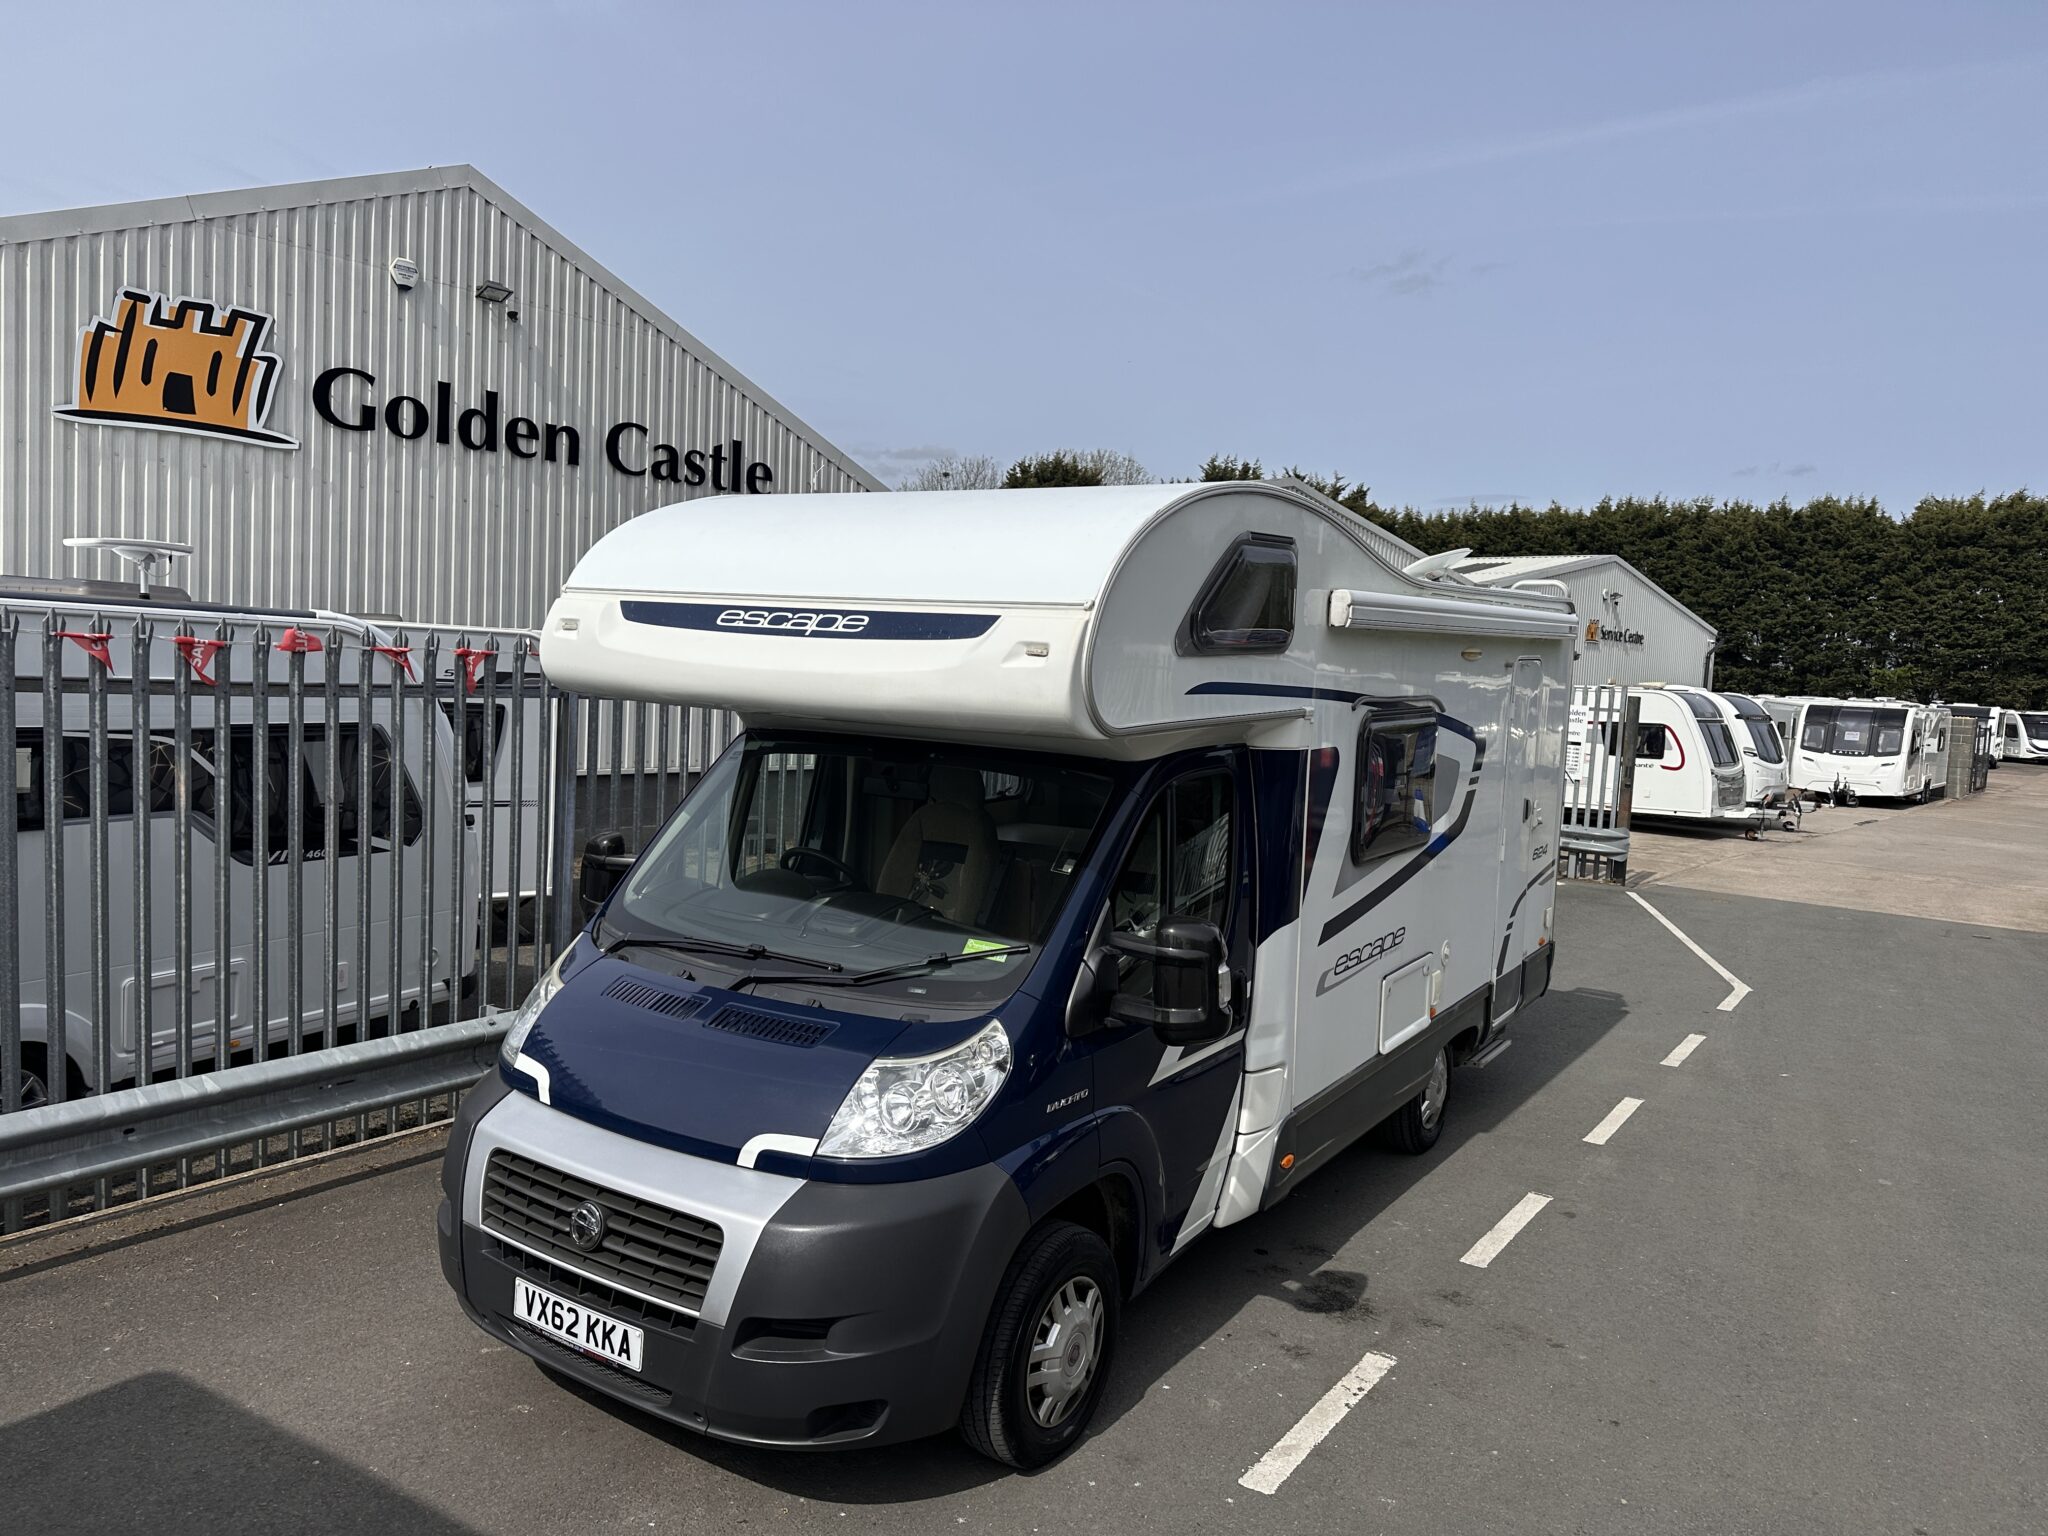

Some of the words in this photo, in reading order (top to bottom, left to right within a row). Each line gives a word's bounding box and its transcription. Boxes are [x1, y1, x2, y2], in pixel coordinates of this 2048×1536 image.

[312, 366, 580, 467] Golden
[605, 421, 774, 495] Castle
[716, 609, 870, 636] escape
[1600, 624, 1623, 642] Service
[1624, 628, 1645, 645] Centre
[1333, 926, 1406, 976] escape
[1046, 1088, 1089, 1113] DUCATO
[524, 1286, 579, 1339] VX62
[585, 1314, 631, 1361] KKA
